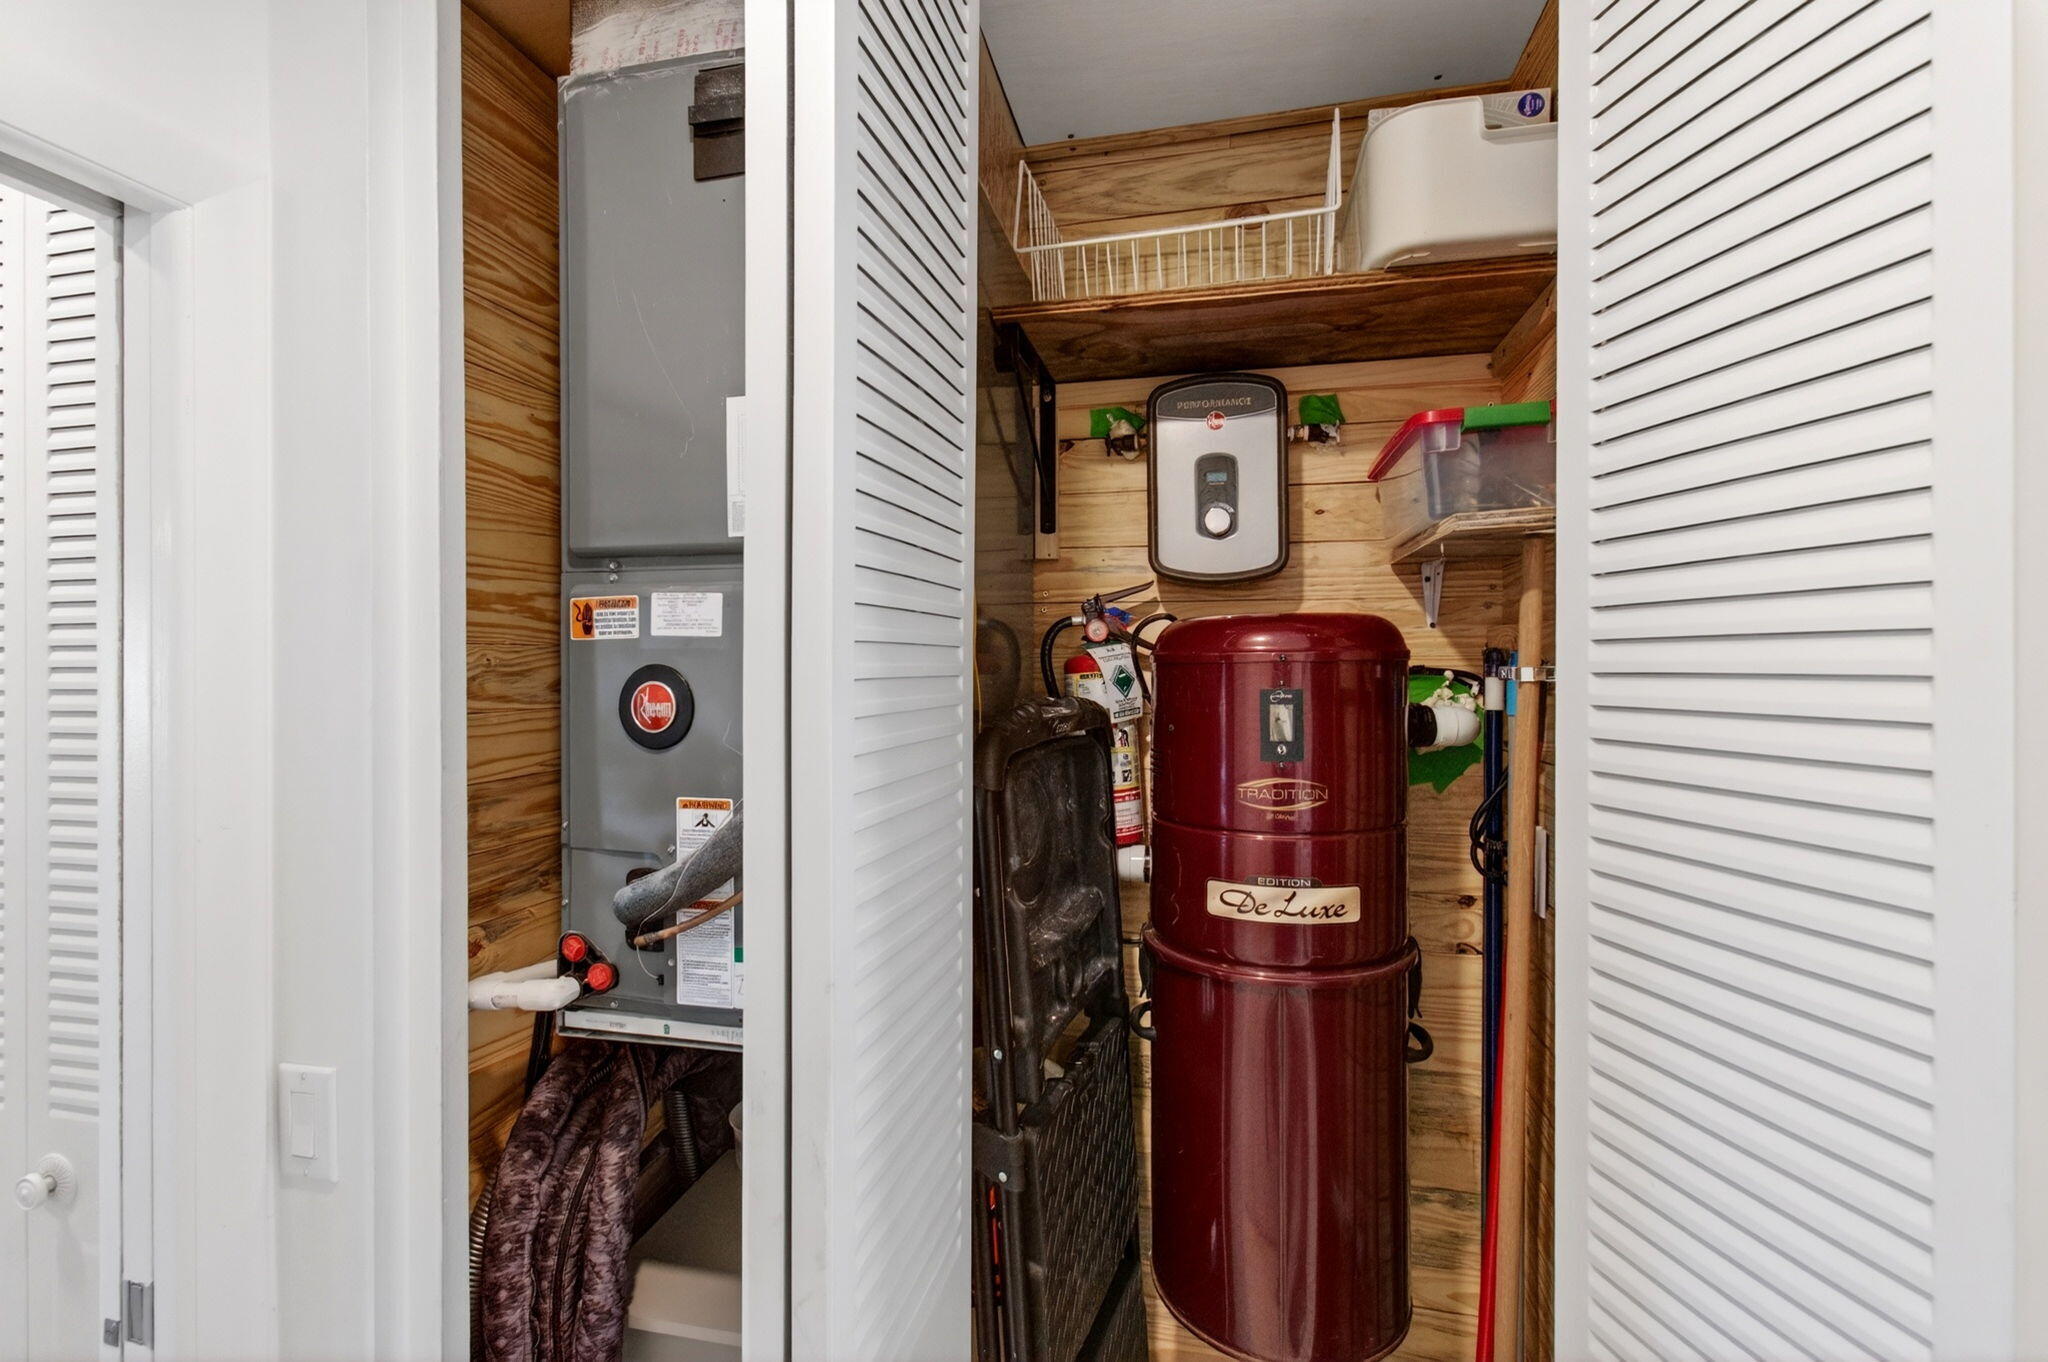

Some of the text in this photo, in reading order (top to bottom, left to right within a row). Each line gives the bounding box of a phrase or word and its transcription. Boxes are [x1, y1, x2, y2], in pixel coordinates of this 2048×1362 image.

[1238, 787, 1328, 801] TRADITION
[1257, 877, 1311, 887] EDITION
[1219, 889, 1348, 919] De Luxe
